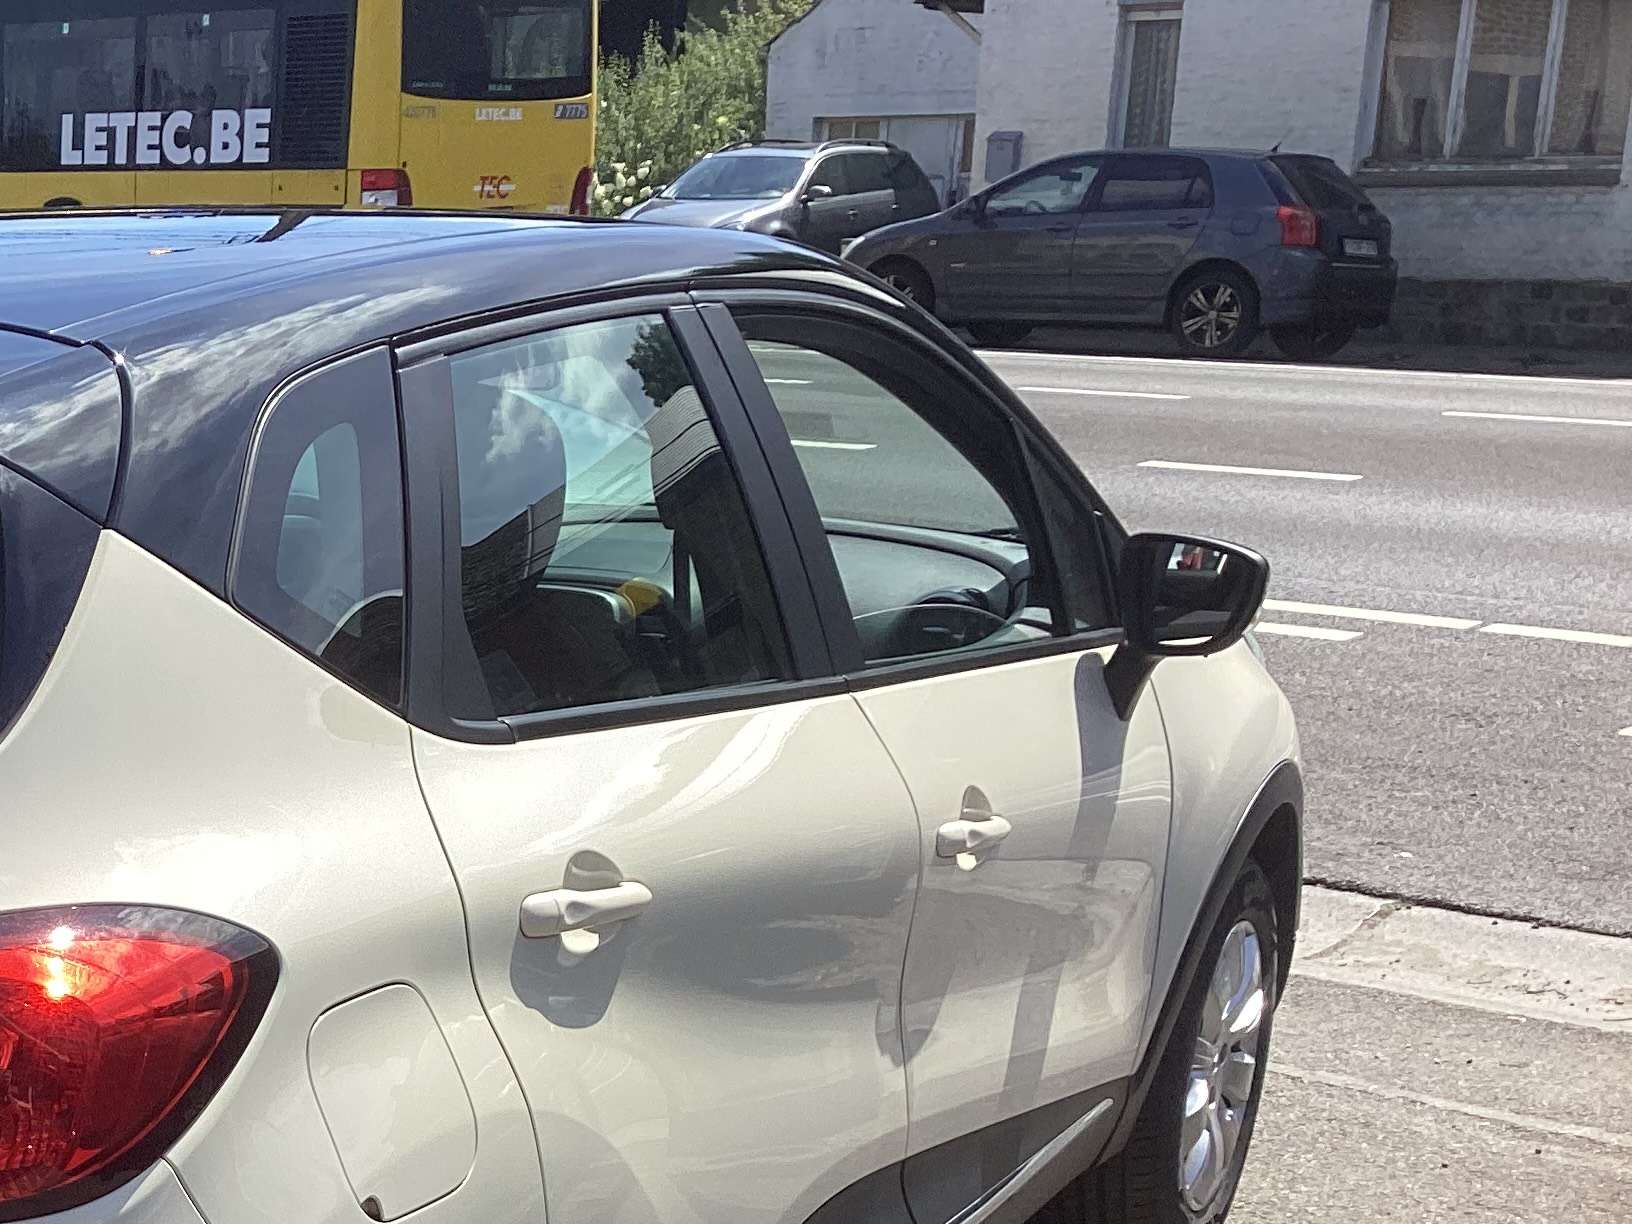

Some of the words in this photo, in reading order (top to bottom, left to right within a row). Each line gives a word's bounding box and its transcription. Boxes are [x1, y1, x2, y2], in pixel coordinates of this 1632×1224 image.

[475, 107, 523, 121] LETEC.BE
[60, 108, 272, 165] LETEC.BE
[478, 175, 512, 199] TEC
